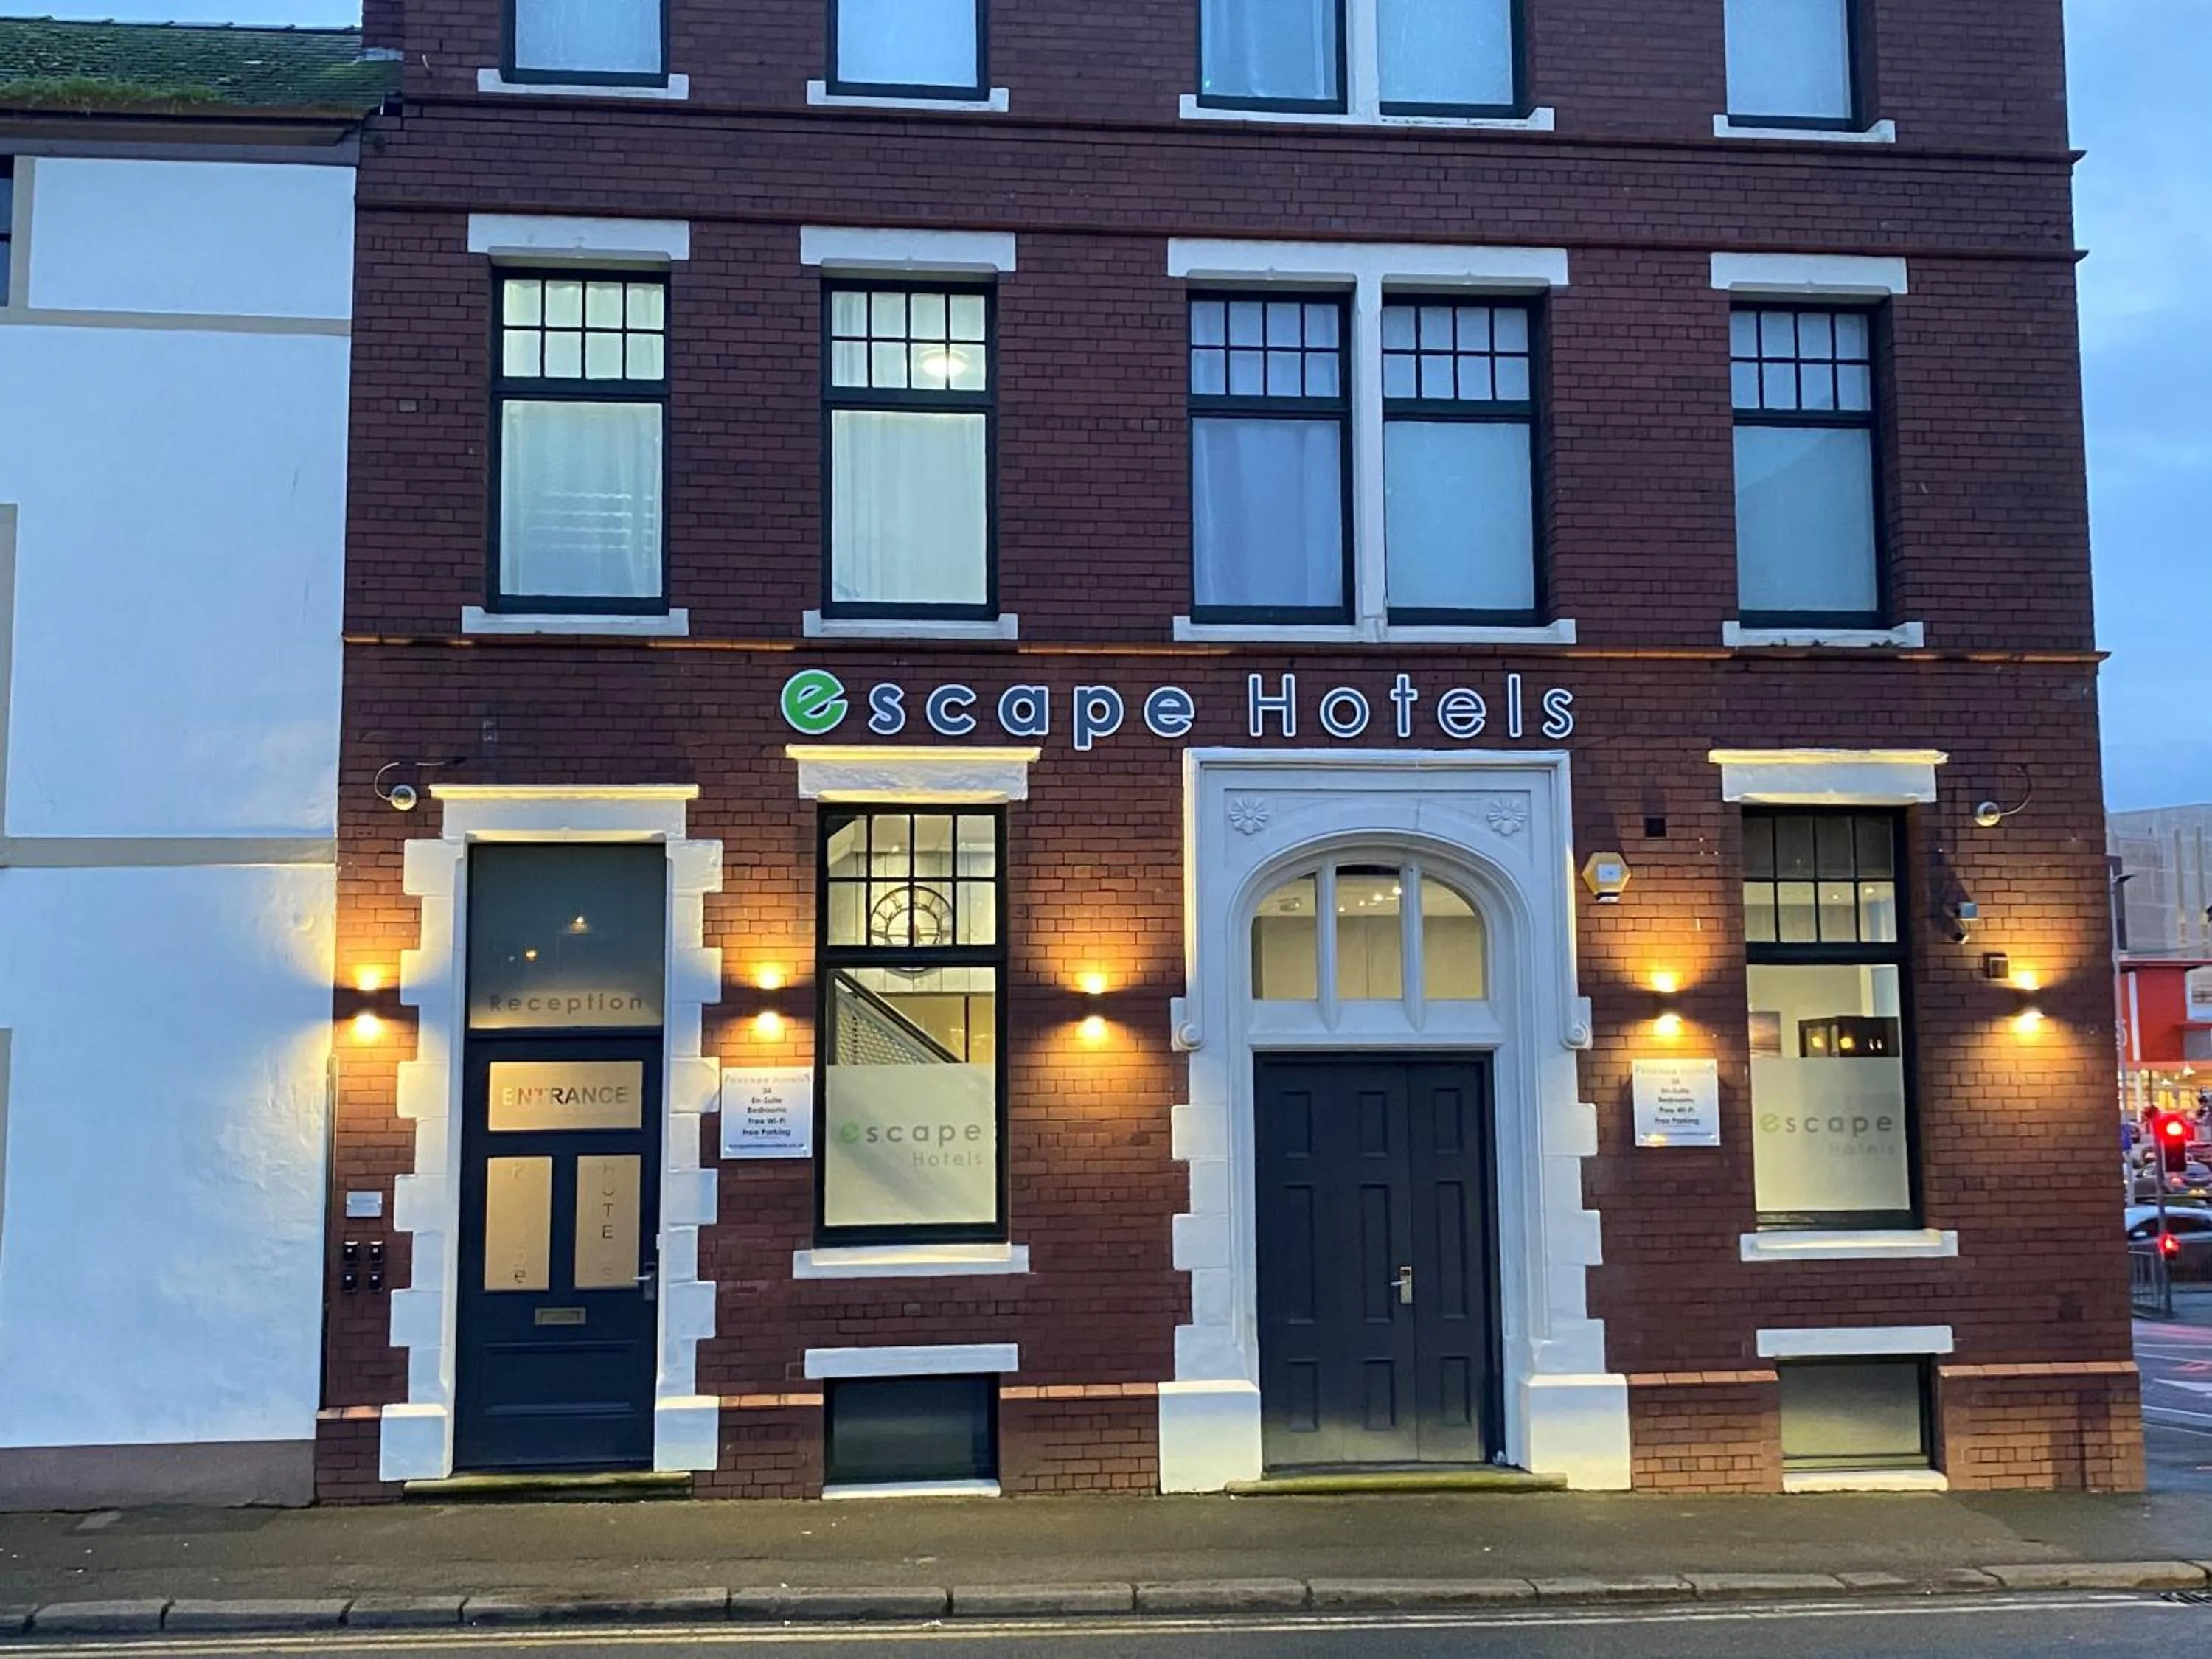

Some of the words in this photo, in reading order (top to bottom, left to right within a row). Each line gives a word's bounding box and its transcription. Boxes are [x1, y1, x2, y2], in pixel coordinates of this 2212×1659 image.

[780, 669, 1195, 751] escape
[1248, 673, 1575, 740] Hotels
[489, 993, 642, 1015] Reception
[502, 1086, 629, 1105] ENTRANCE
[742, 1128, 760, 1136] Free
[762, 1128, 791, 1137] Parking
[838, 1122, 982, 1148] escape
[1760, 1113, 1893, 1138] escape
[912, 1150, 984, 1167] Hotels
